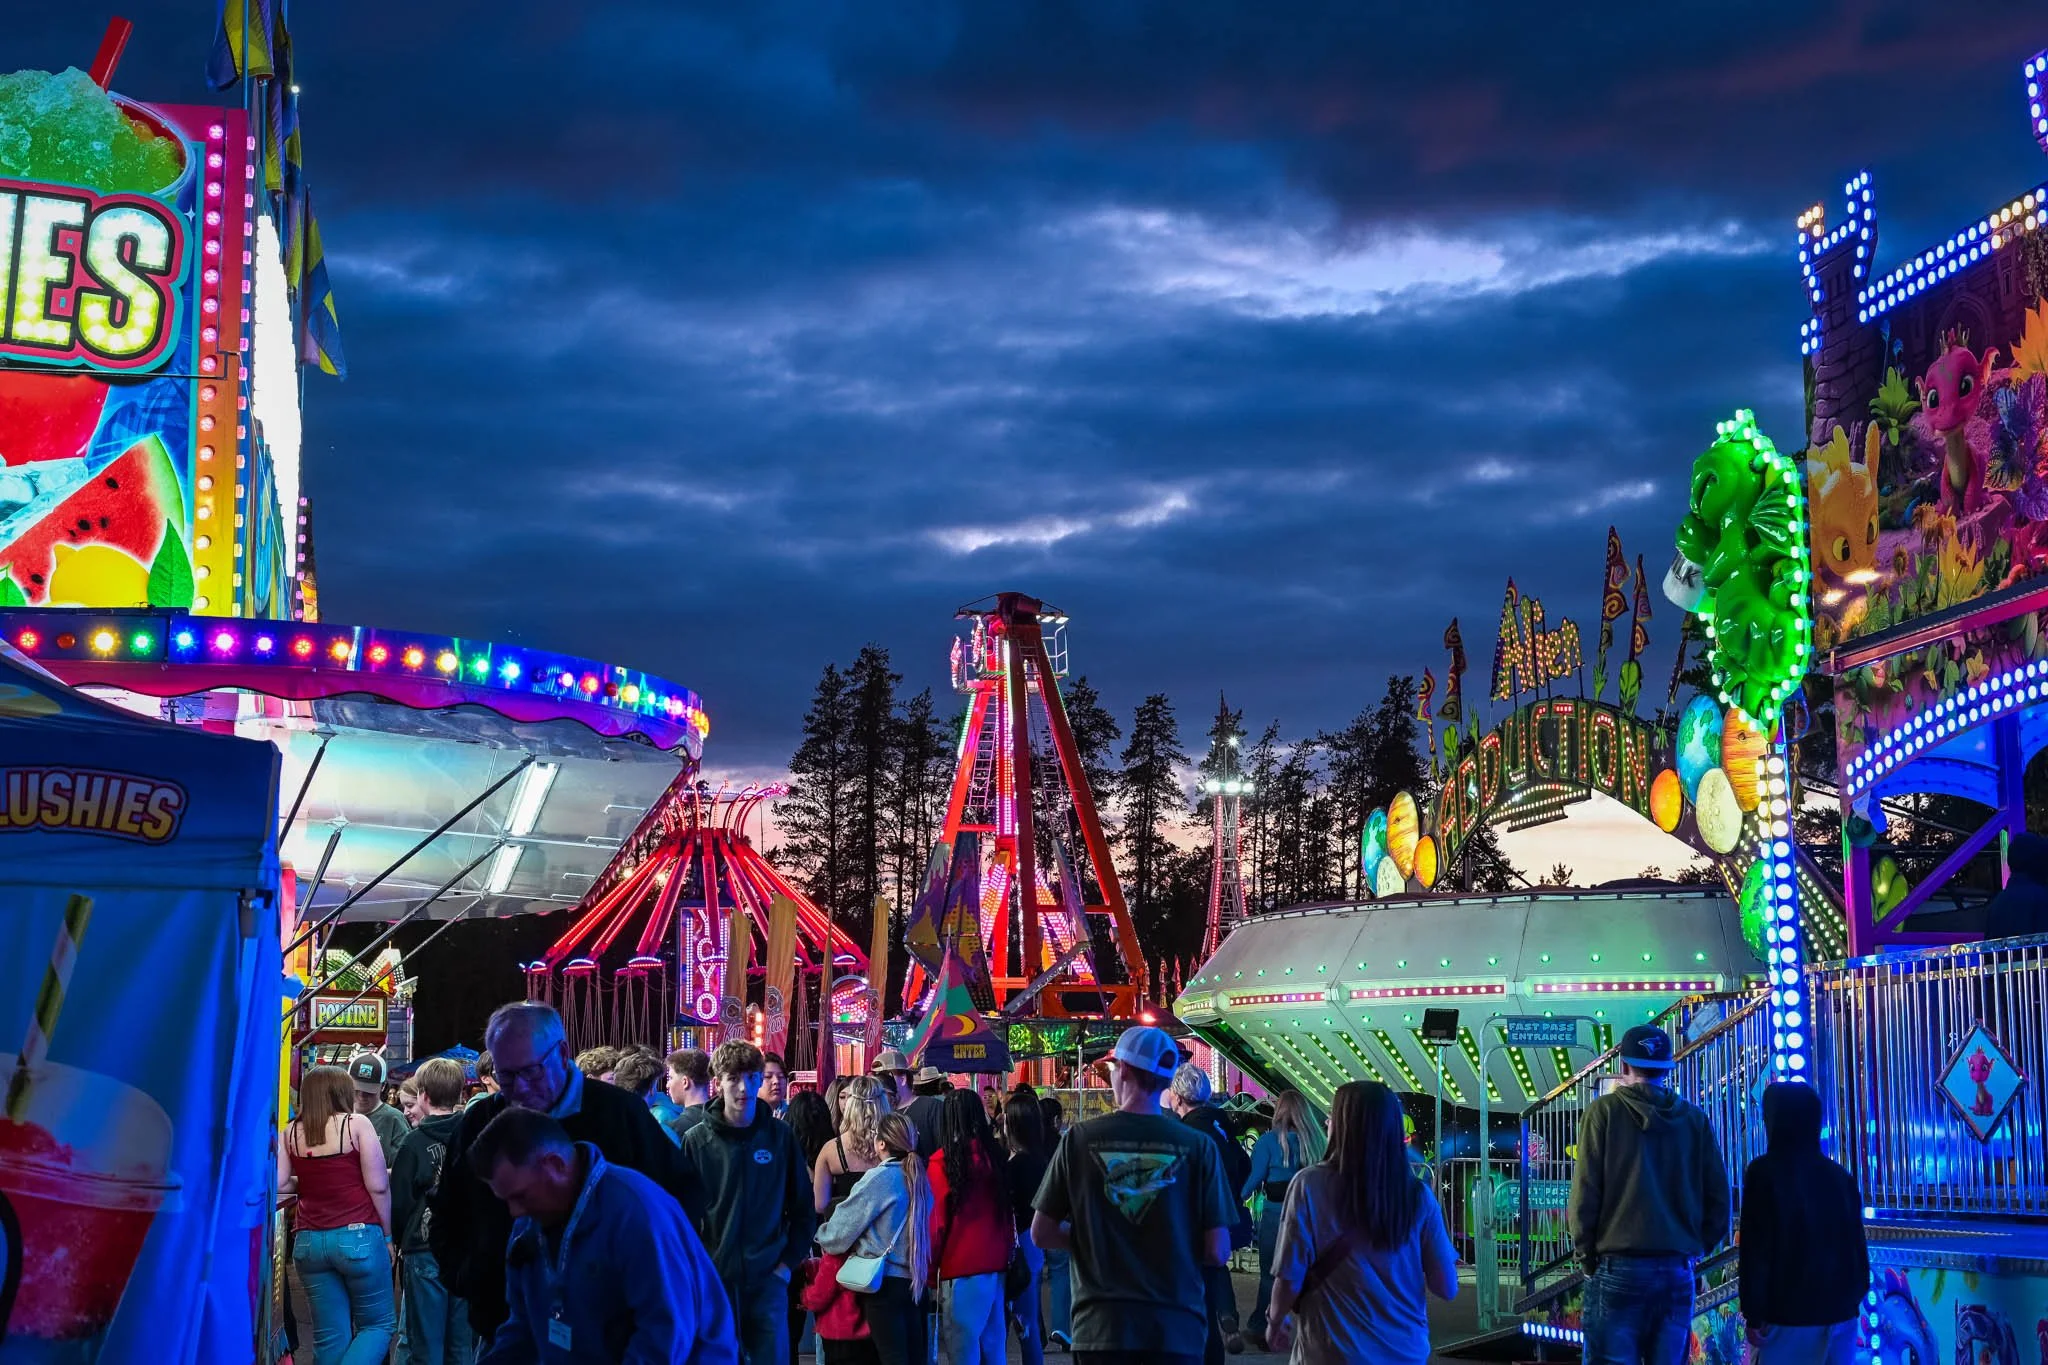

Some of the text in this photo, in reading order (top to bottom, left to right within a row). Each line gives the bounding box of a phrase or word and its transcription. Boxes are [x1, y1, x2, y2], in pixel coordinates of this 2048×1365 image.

[1499, 594, 1583, 700] Alien
[1440, 699, 1650, 870] ABDUCTION
[0, 772, 180, 840] USHIES
[318, 1002, 377, 1027] POUTINE
[1508, 1022, 1575, 1032] FAST PASS
[1511, 1033, 1573, 1041] ENTRANCE
[953, 1044, 986, 1059] ENTER
